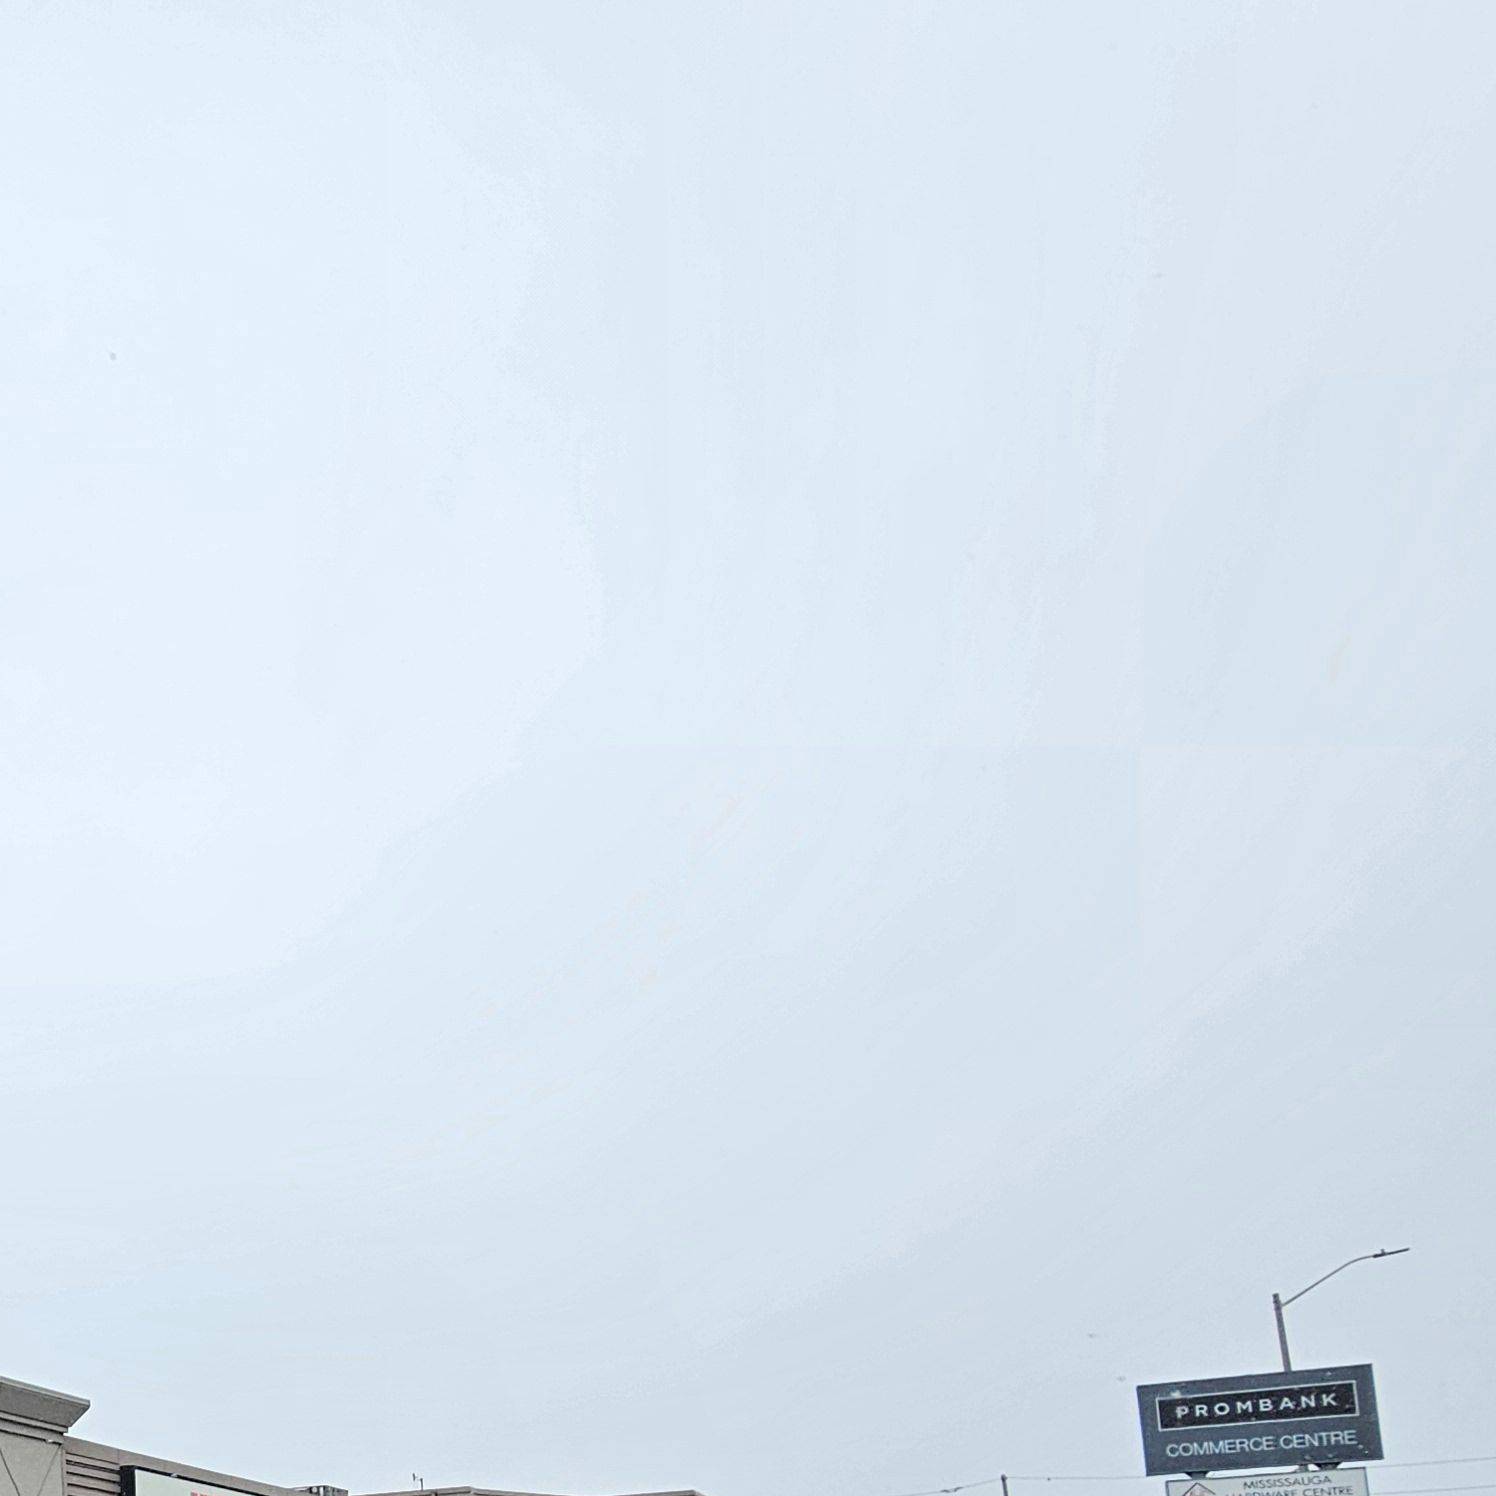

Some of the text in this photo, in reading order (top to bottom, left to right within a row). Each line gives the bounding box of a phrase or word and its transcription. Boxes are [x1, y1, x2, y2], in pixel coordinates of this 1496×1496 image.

[1175, 1393, 1338, 1420] PROMBANK
[1165, 1430, 1359, 1458] COMMERCE CENTRE
[1243, 1475, 1333, 1491] MISSISSAUGA
